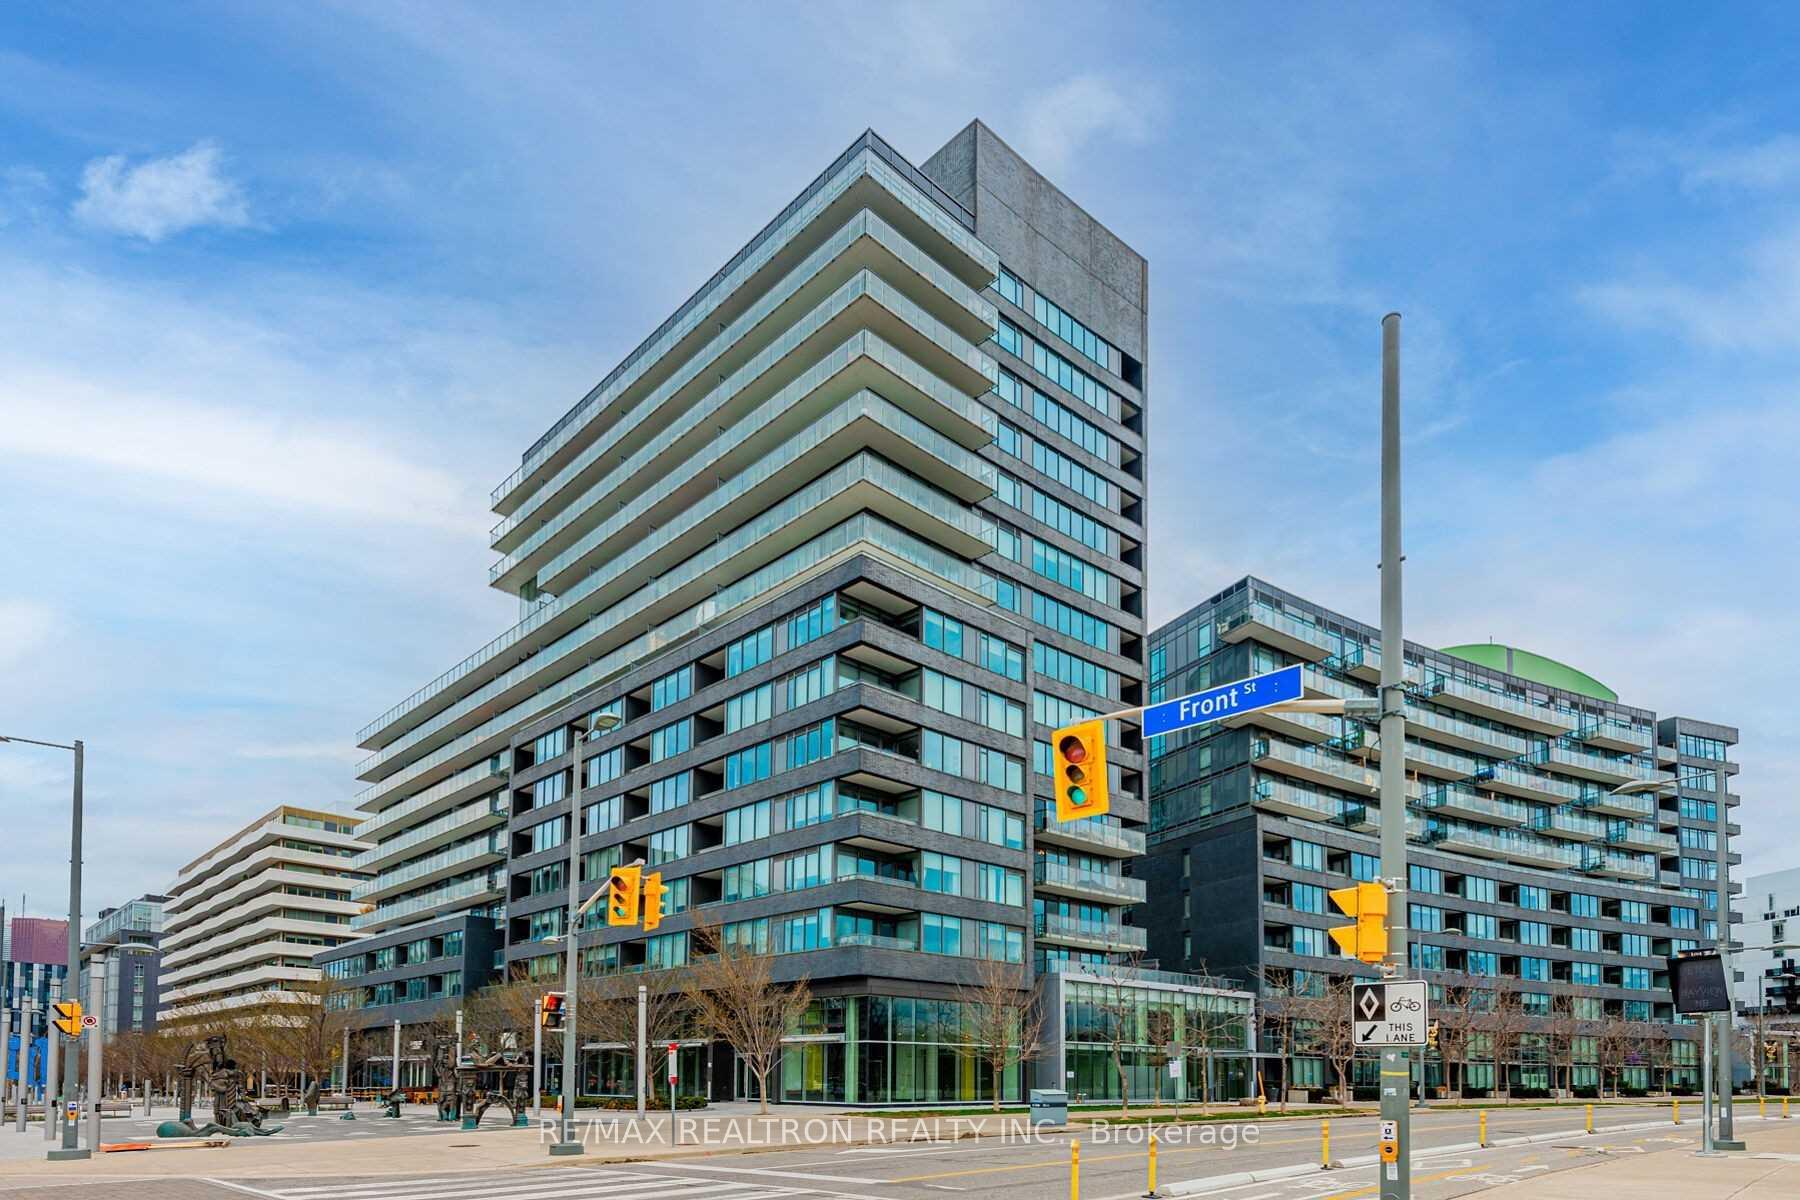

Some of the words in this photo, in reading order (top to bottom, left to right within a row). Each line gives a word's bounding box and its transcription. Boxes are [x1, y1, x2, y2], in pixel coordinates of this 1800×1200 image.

[1180, 688, 1238, 721] Front
[1243, 682, 1257, 695] St
[1388, 1023, 1413, 1032] THIS
[1385, 1033, 1415, 1042] LANE
